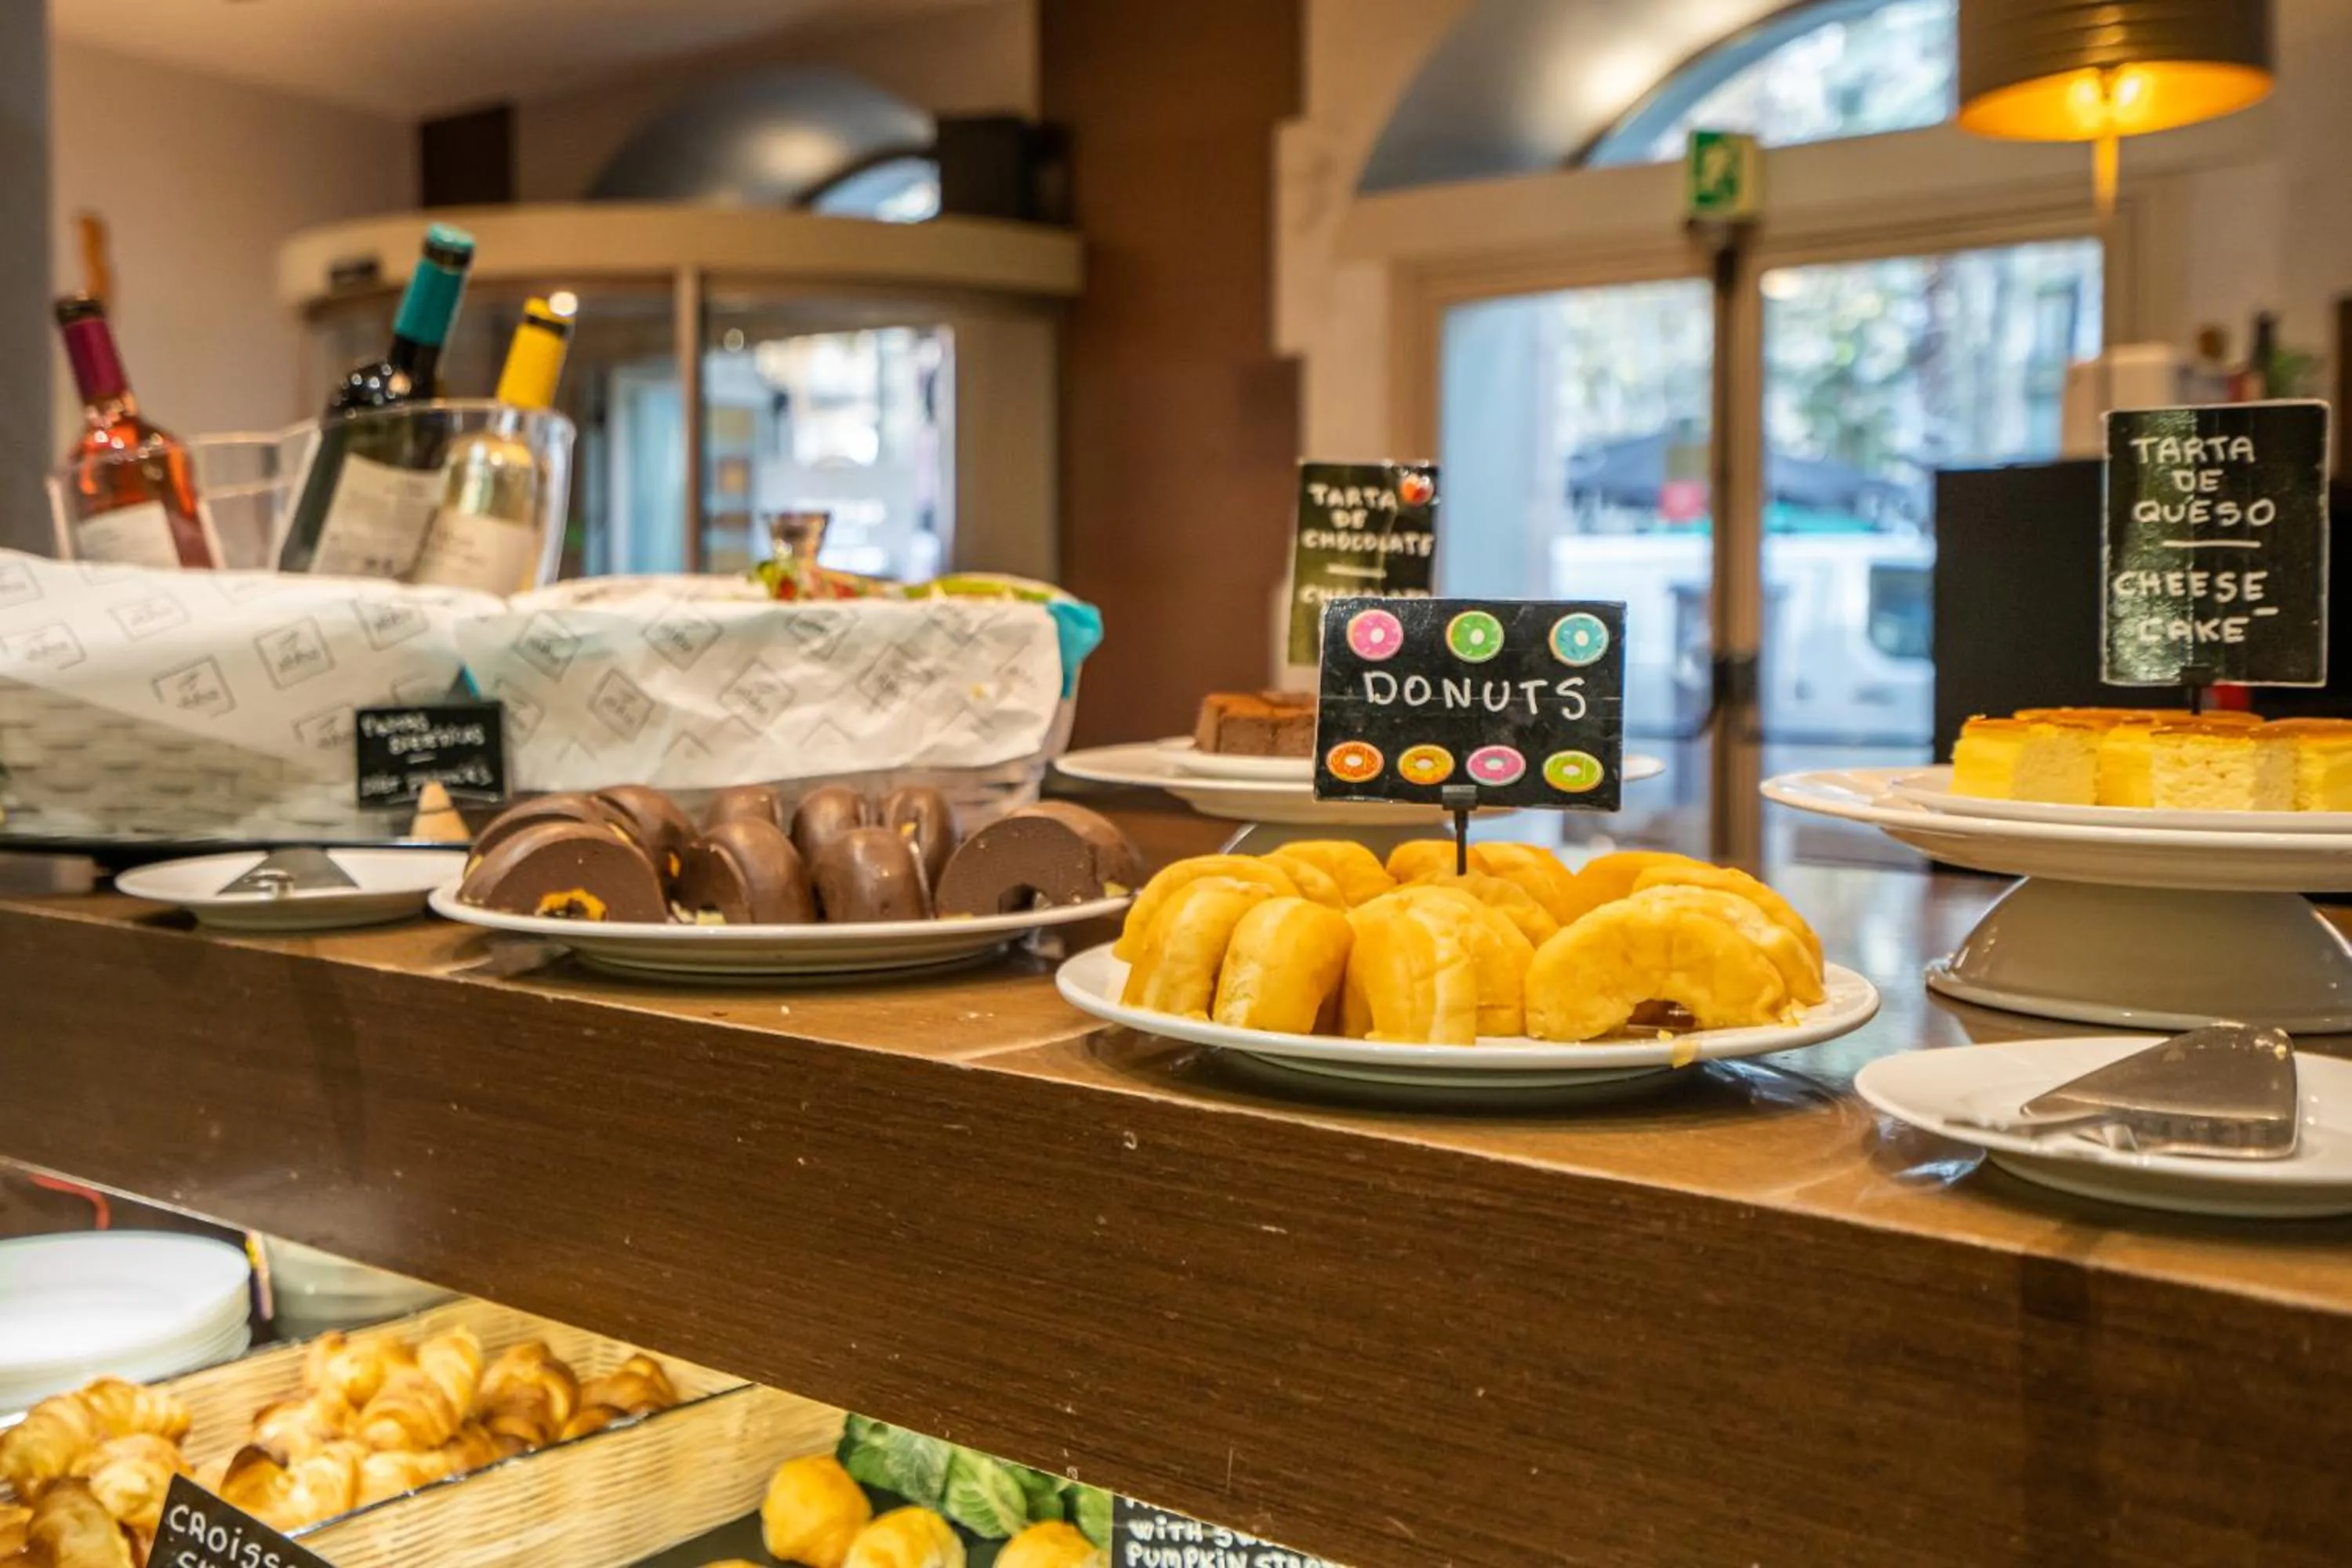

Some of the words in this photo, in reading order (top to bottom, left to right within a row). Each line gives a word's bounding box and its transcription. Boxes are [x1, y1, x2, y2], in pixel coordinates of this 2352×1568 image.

[2130, 436, 2256, 463] TARTA
[2173, 470, 2223, 492] DE
[1307, 483, 1398, 510] TARTA
[1330, 508, 1368, 530] DE
[2132, 498, 2277, 526] QUESO
[1301, 528, 1435, 557] CHOCOLATE
[2137, 616, 2250, 643] CAKE
[1363, 670, 1587, 720] DONUTS
